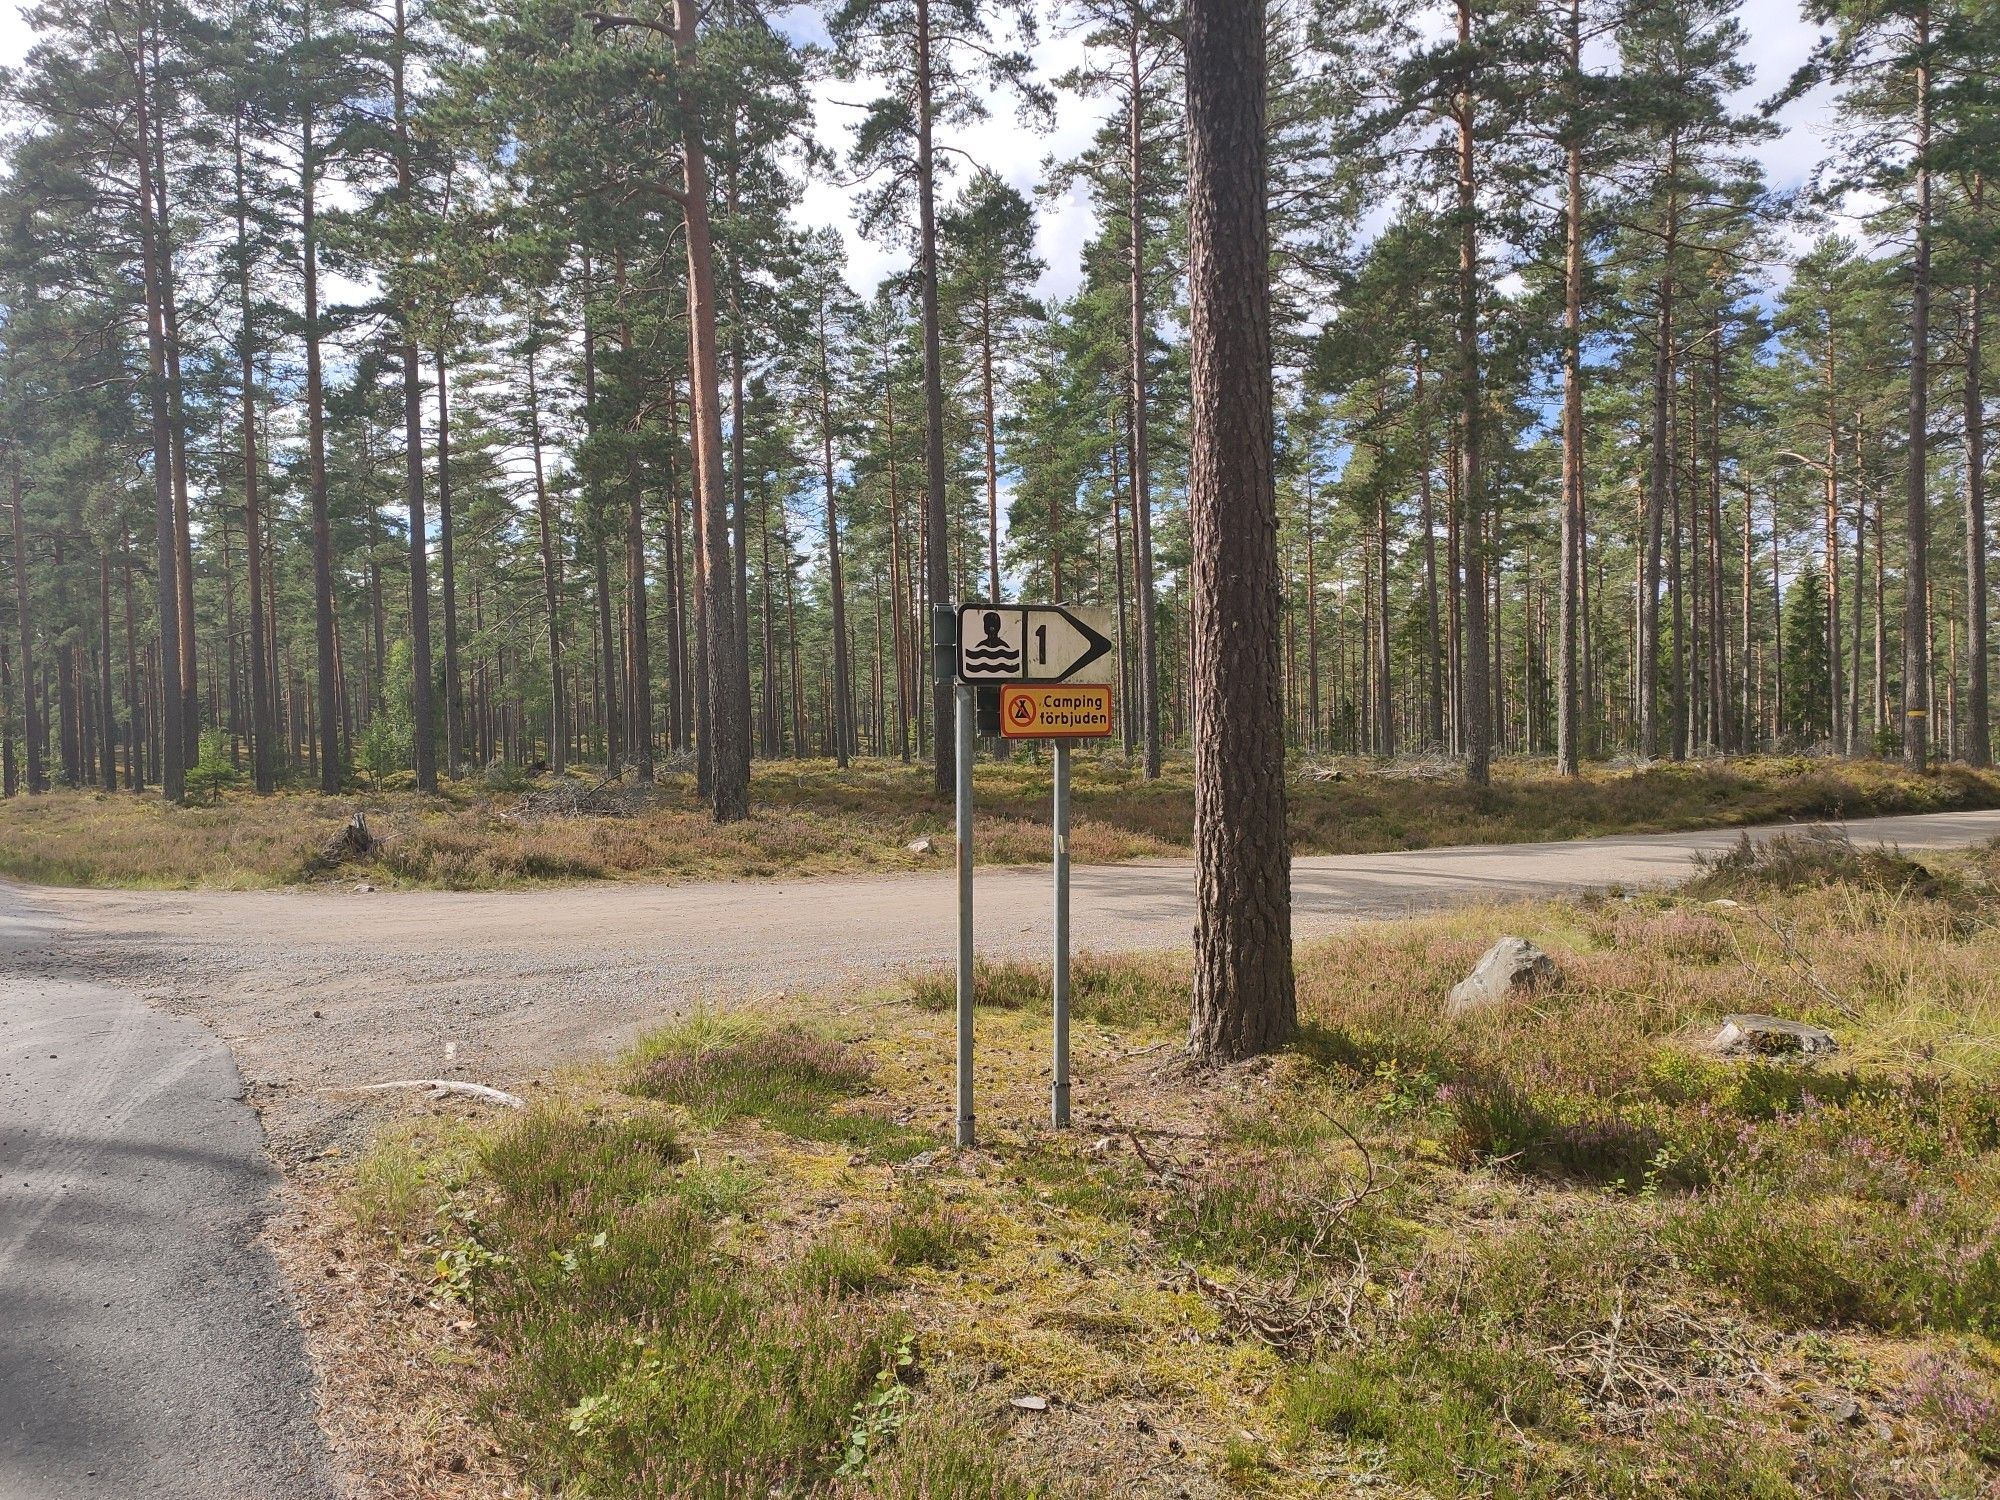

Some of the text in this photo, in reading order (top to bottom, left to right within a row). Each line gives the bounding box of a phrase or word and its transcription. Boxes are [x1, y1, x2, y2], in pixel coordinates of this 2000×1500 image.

[1035, 624, 1047, 665] 1
[1043, 695, 1102, 710] Camping
[1040, 712, 1107, 727] förbjuden
